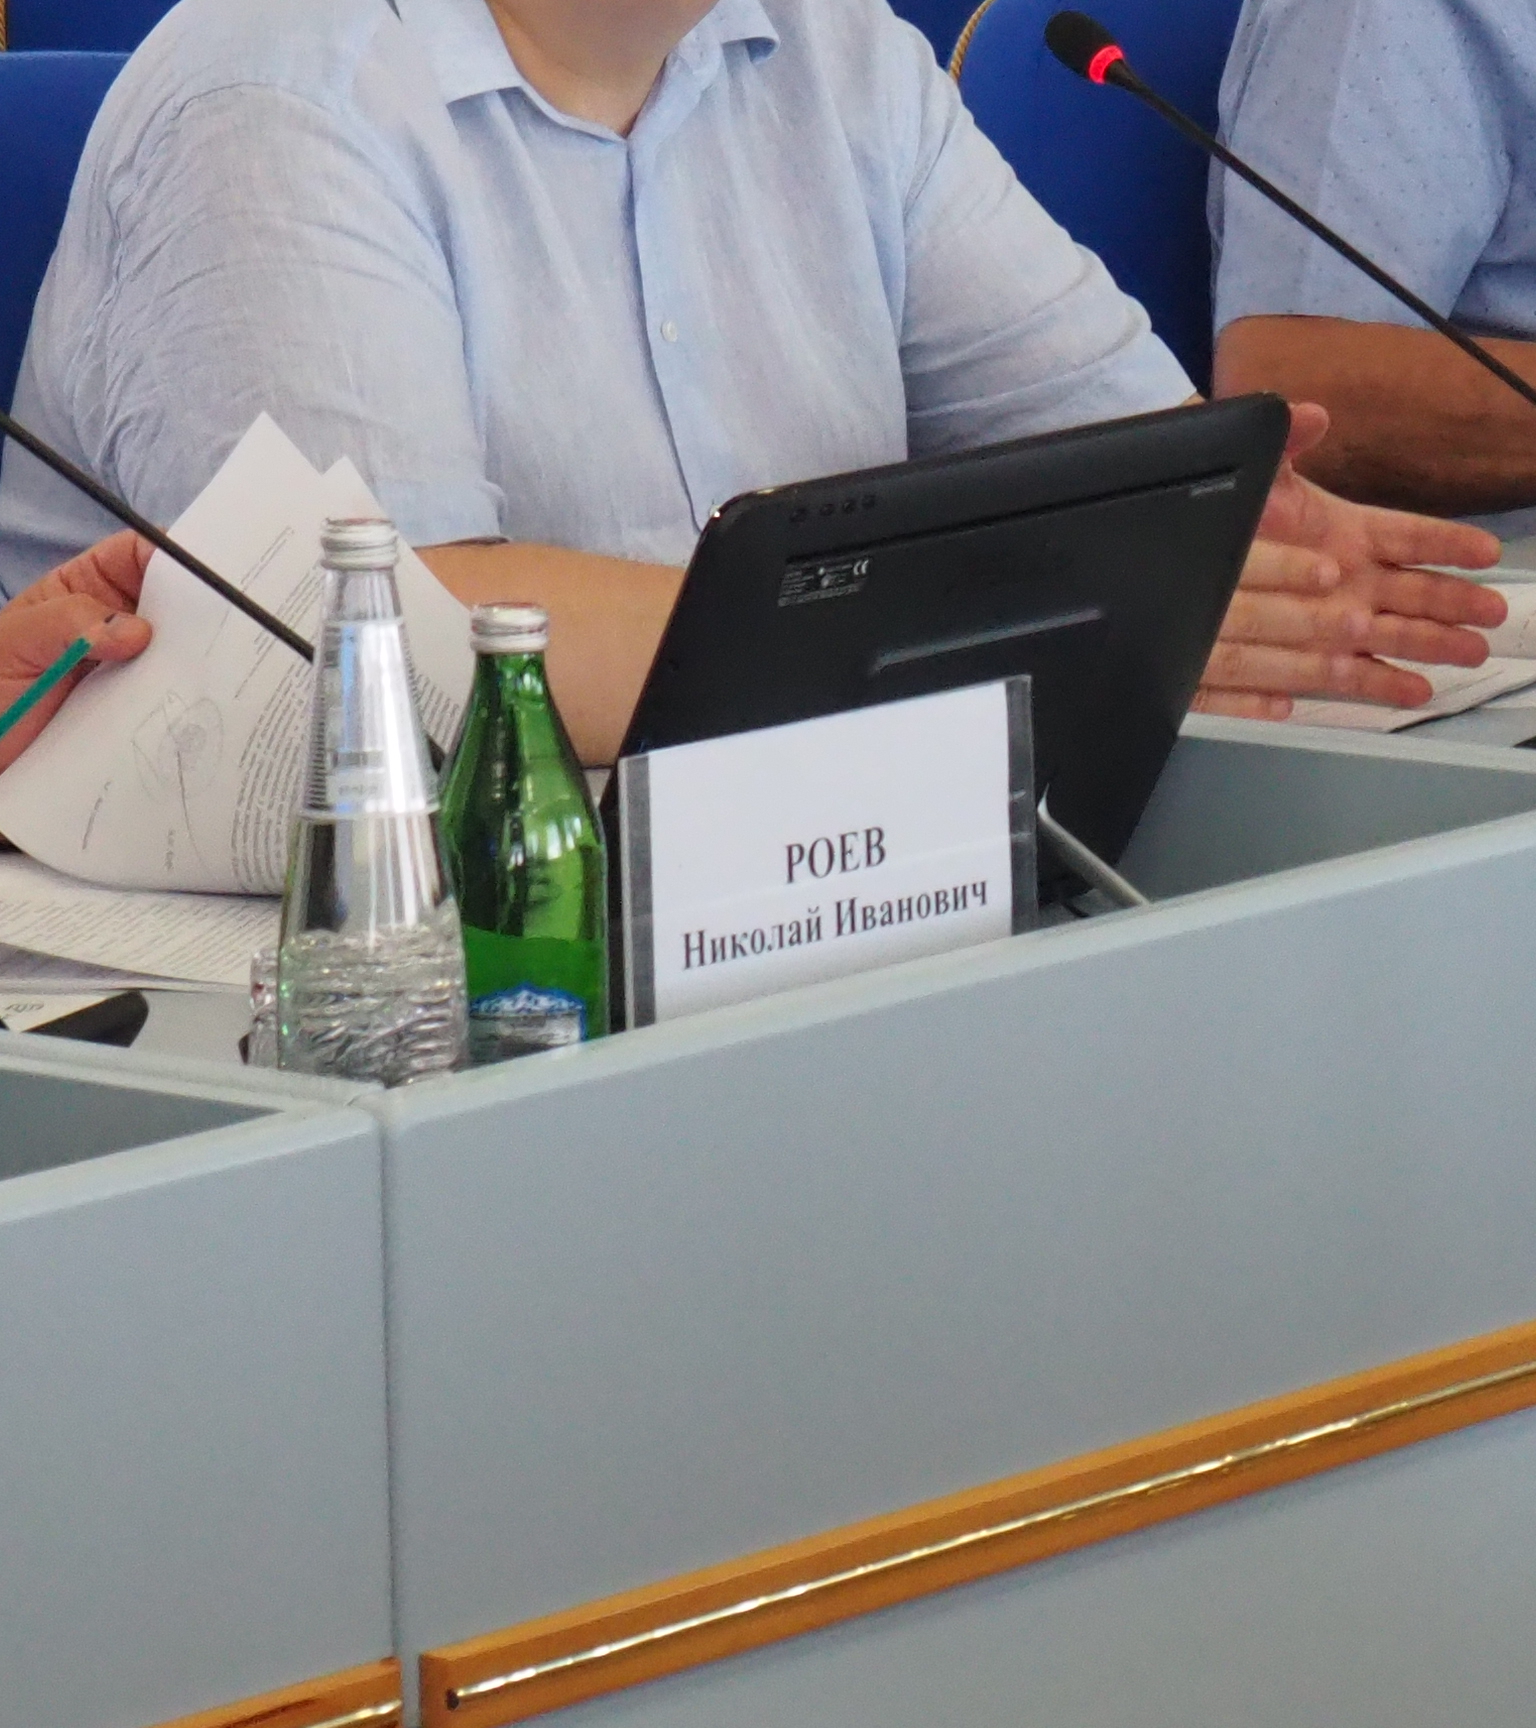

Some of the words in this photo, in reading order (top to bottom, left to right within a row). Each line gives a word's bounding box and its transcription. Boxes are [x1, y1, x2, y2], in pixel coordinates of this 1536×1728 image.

[786, 827, 886, 884] РОЕВ
[684, 906, 822, 970] Николай
[835, 881, 987, 937] Иванович
